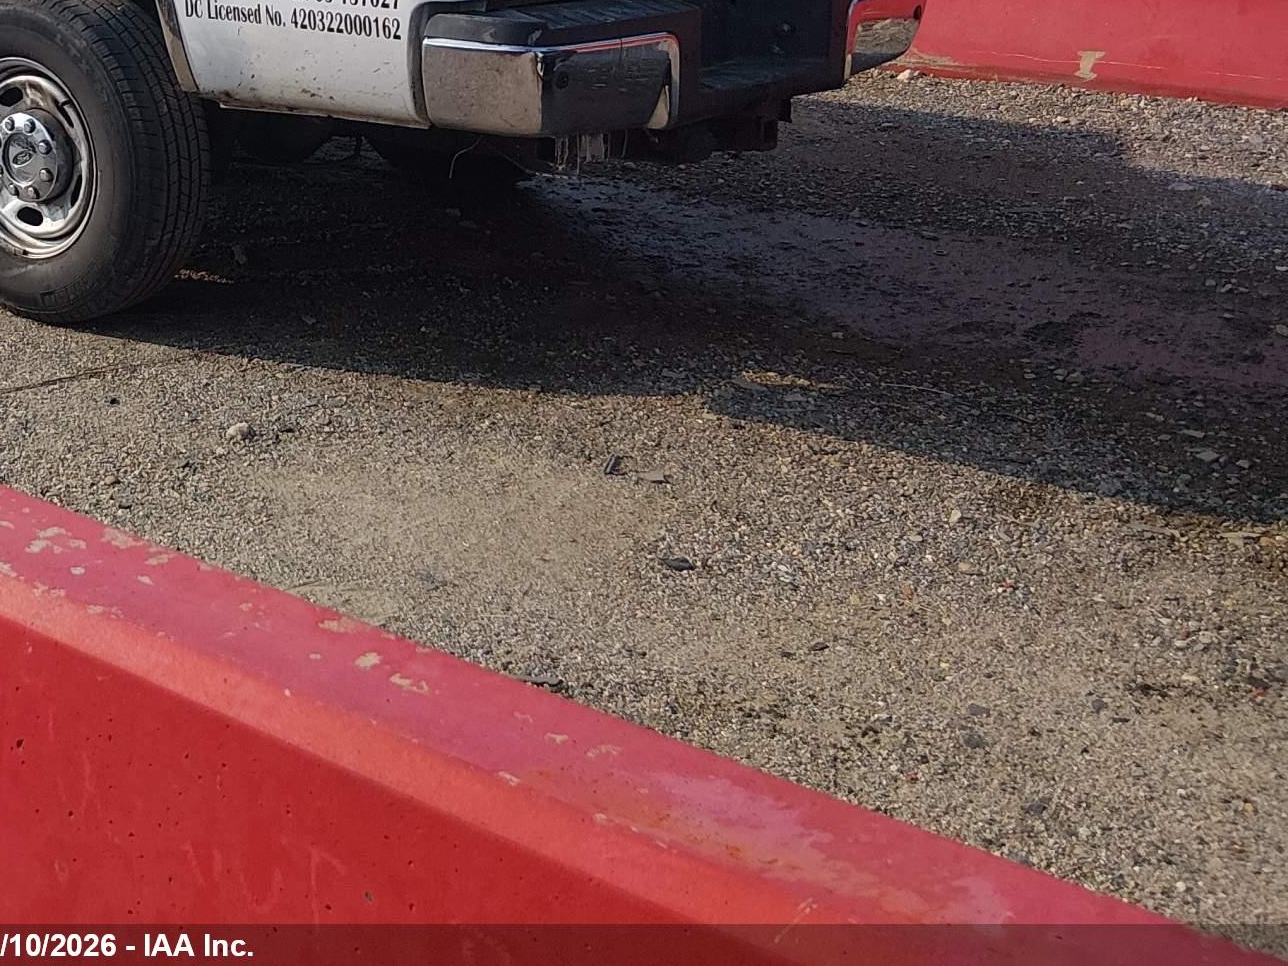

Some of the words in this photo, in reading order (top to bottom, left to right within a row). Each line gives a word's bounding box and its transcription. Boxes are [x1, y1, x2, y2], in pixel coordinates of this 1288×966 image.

[207, 0, 262, 25] Licensed
[265, 4, 286, 27] No.
[290, 7, 402, 40] 420322000162
